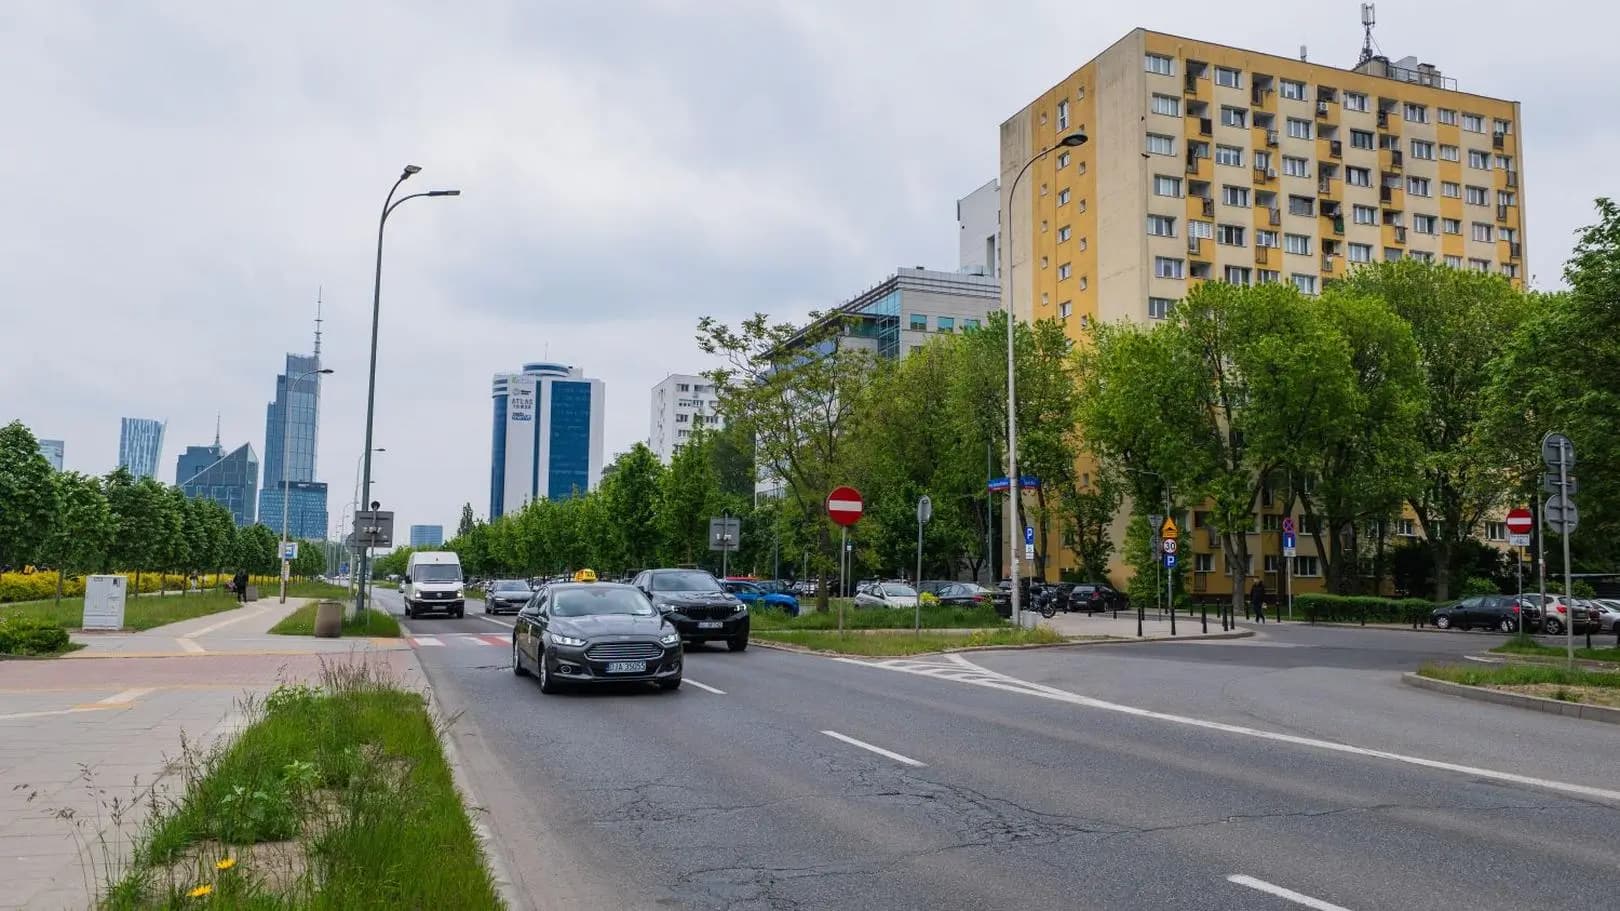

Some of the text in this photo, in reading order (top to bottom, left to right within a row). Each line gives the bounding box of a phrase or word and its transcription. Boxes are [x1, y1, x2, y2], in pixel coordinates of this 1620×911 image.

[1027, 528, 1033, 540] P
[1165, 541, 1176, 551] 30
[1167, 556, 1175, 566] P
